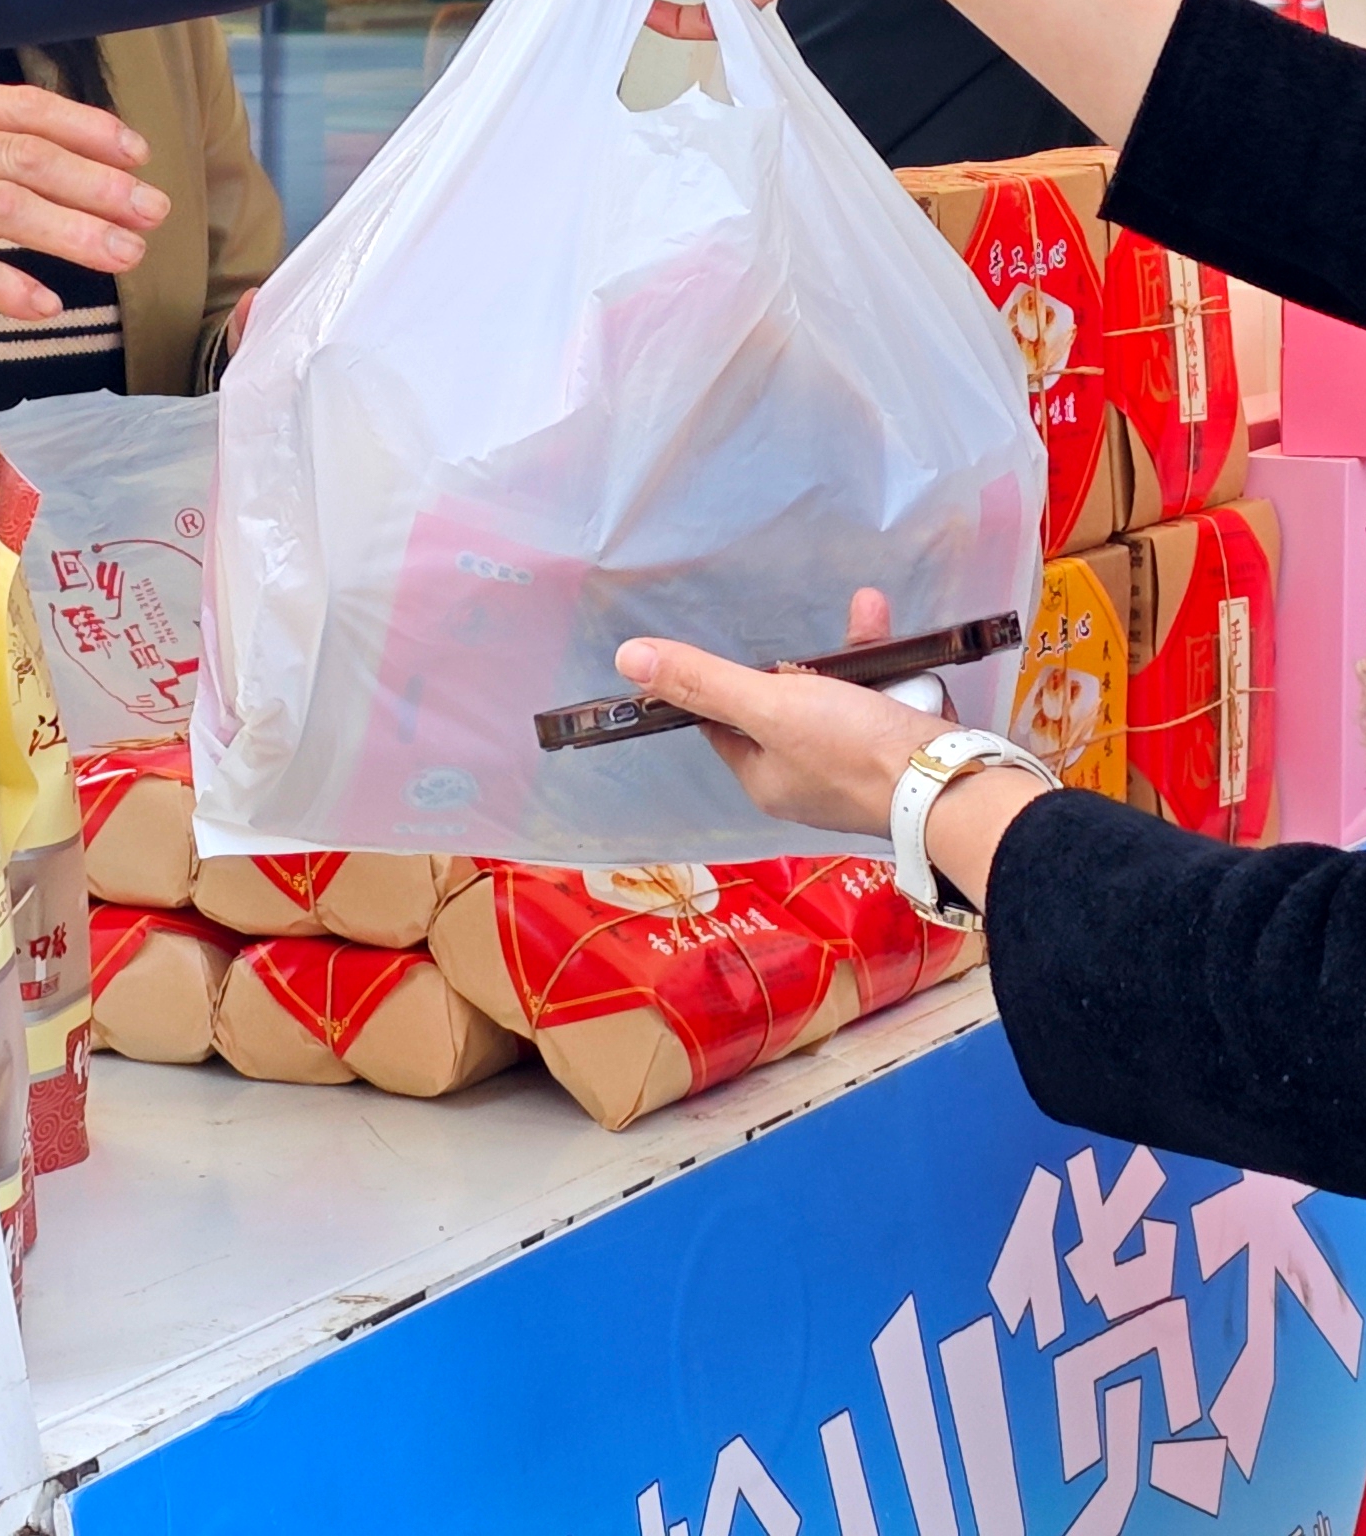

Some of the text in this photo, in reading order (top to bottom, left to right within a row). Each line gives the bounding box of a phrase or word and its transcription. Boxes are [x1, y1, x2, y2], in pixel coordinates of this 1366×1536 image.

[647, 907, 779, 957] 舌尖上的味道
